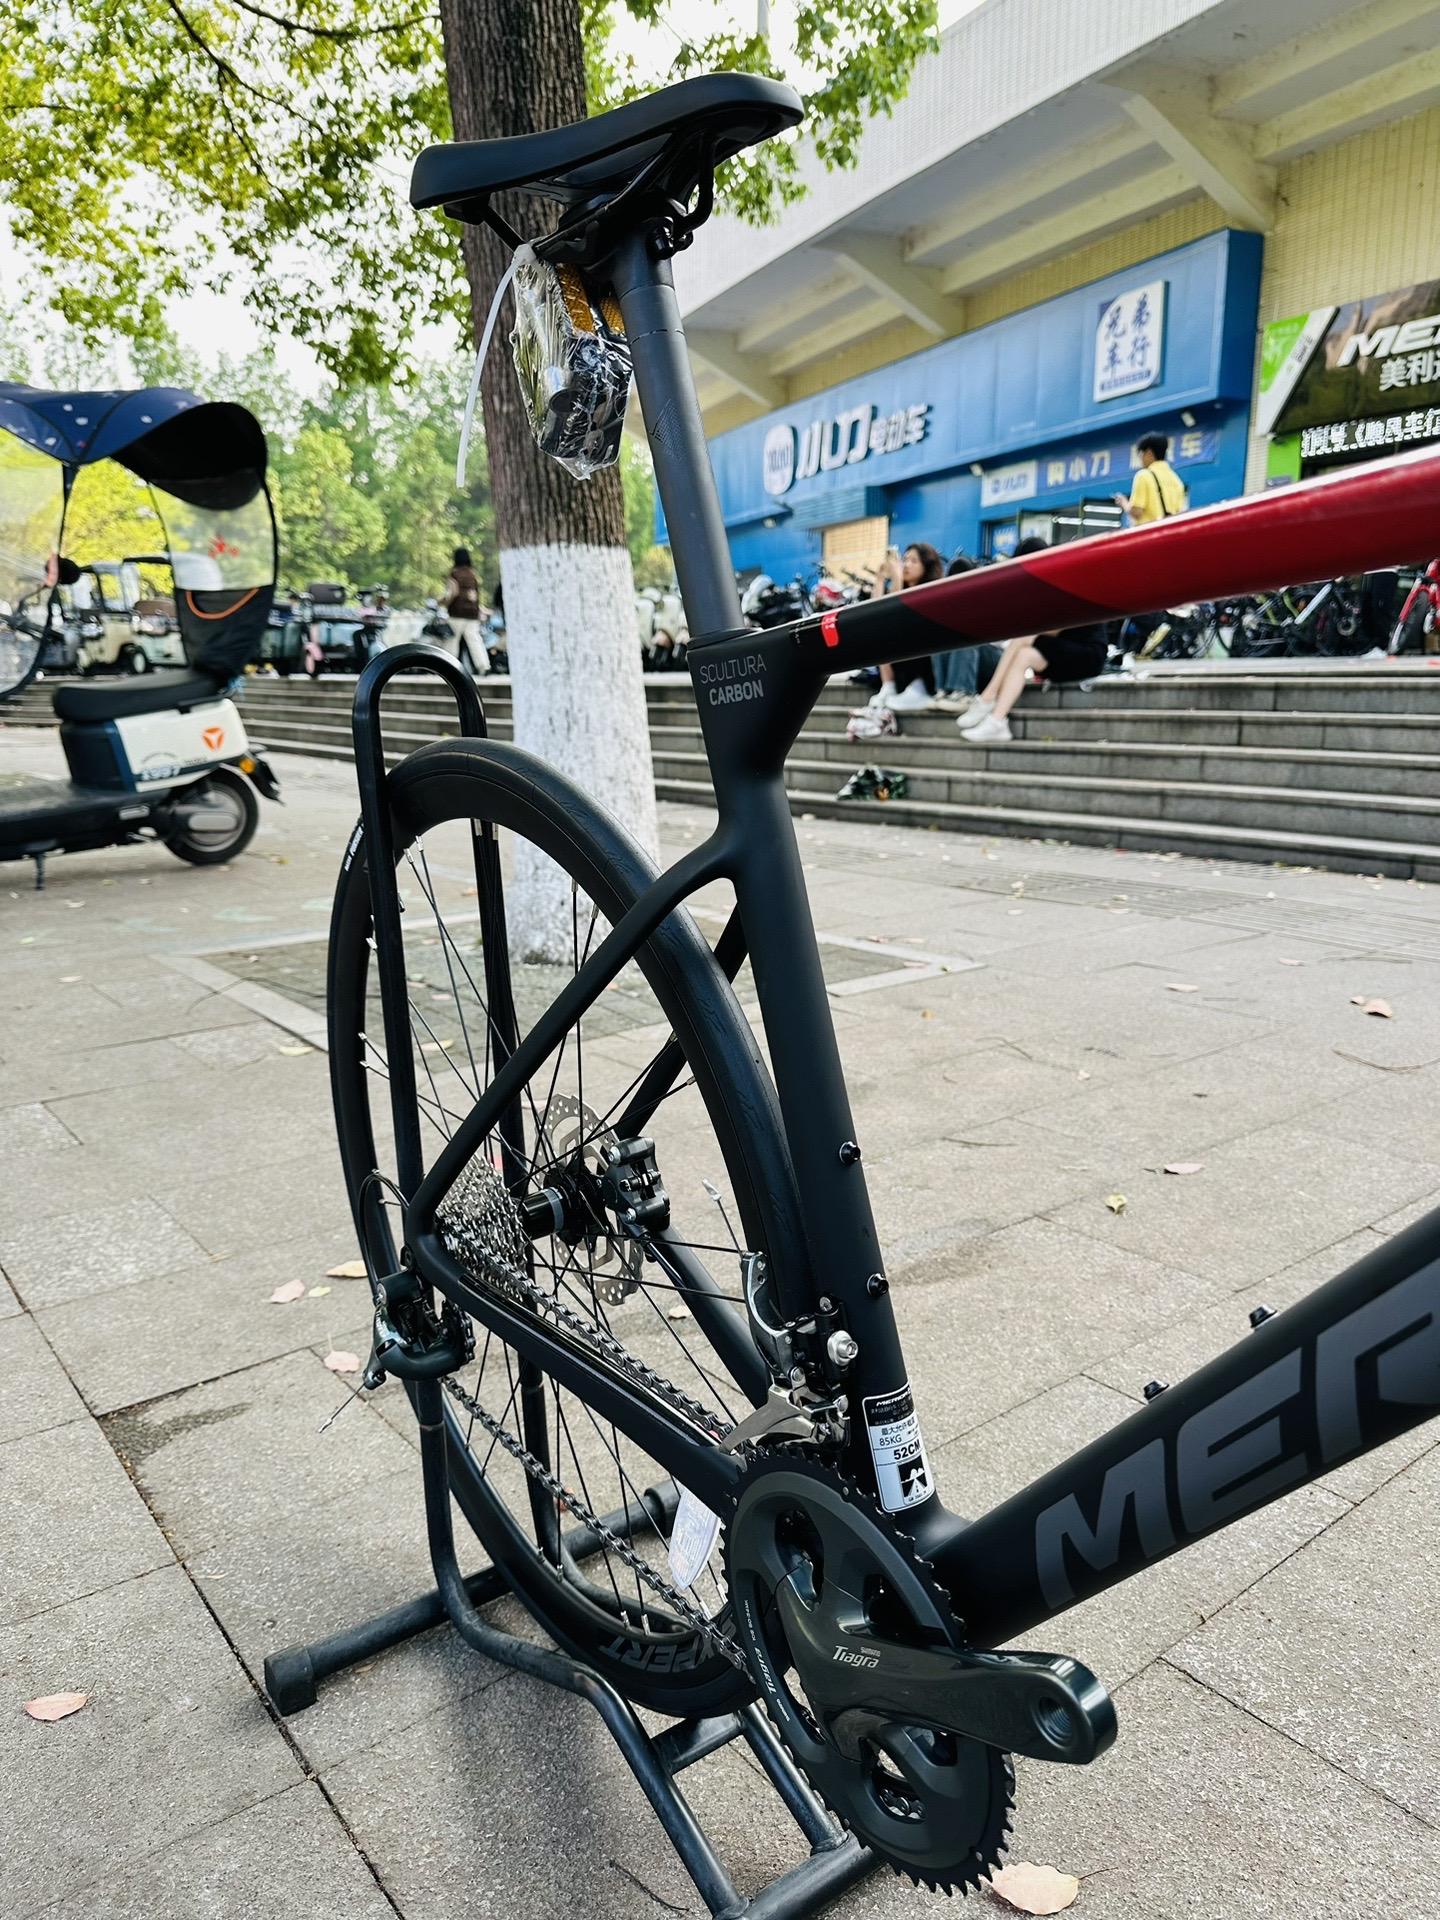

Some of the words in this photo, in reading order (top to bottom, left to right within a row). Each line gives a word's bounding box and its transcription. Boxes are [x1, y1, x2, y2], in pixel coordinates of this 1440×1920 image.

[1336, 314, 1440, 367] ME
[700, 654, 767, 684] SCULTURA
[709, 680, 764, 706] CARBON
[879, 1434, 902, 1447] 85KG
[893, 1438, 920, 1461] 52CM
[833, 1645, 879, 1668] Tiagra
